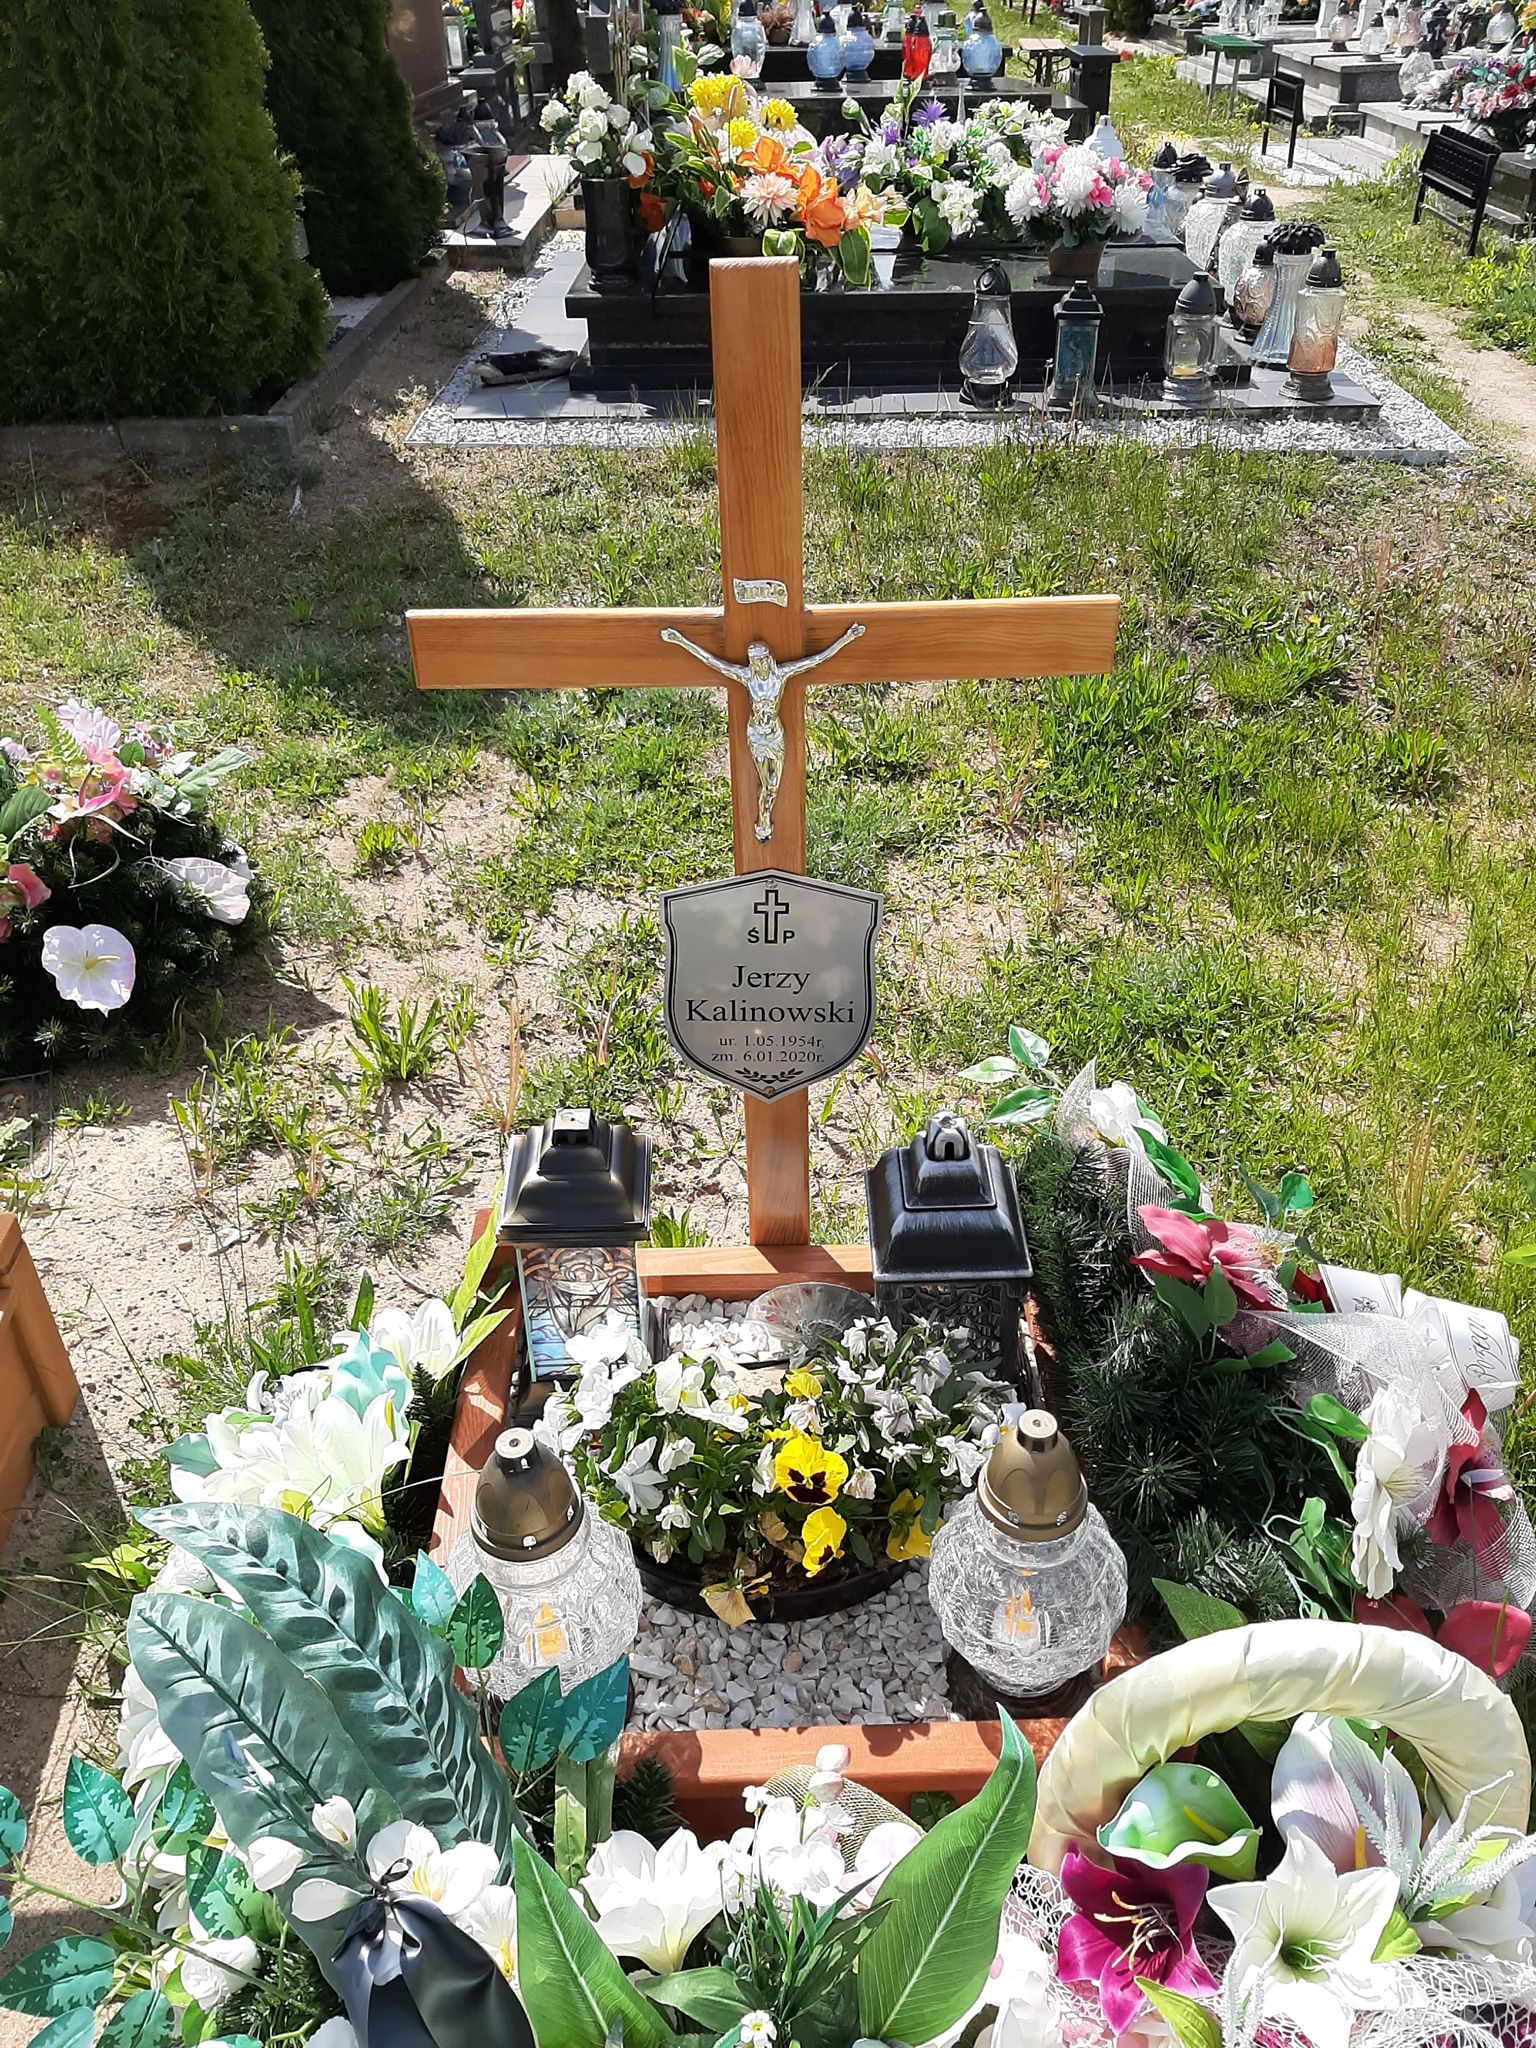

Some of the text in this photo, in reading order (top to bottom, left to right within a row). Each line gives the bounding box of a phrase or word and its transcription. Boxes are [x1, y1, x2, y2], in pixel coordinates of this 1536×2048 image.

[747, 926, 796, 944] Ś P
[731, 965, 811, 995] Jerzy
[685, 999, 855, 1023] Kalinowski
[719, 1037, 737, 1047] ur.
[711, 1050, 825, 1063] zm. 6.01.2020r.
